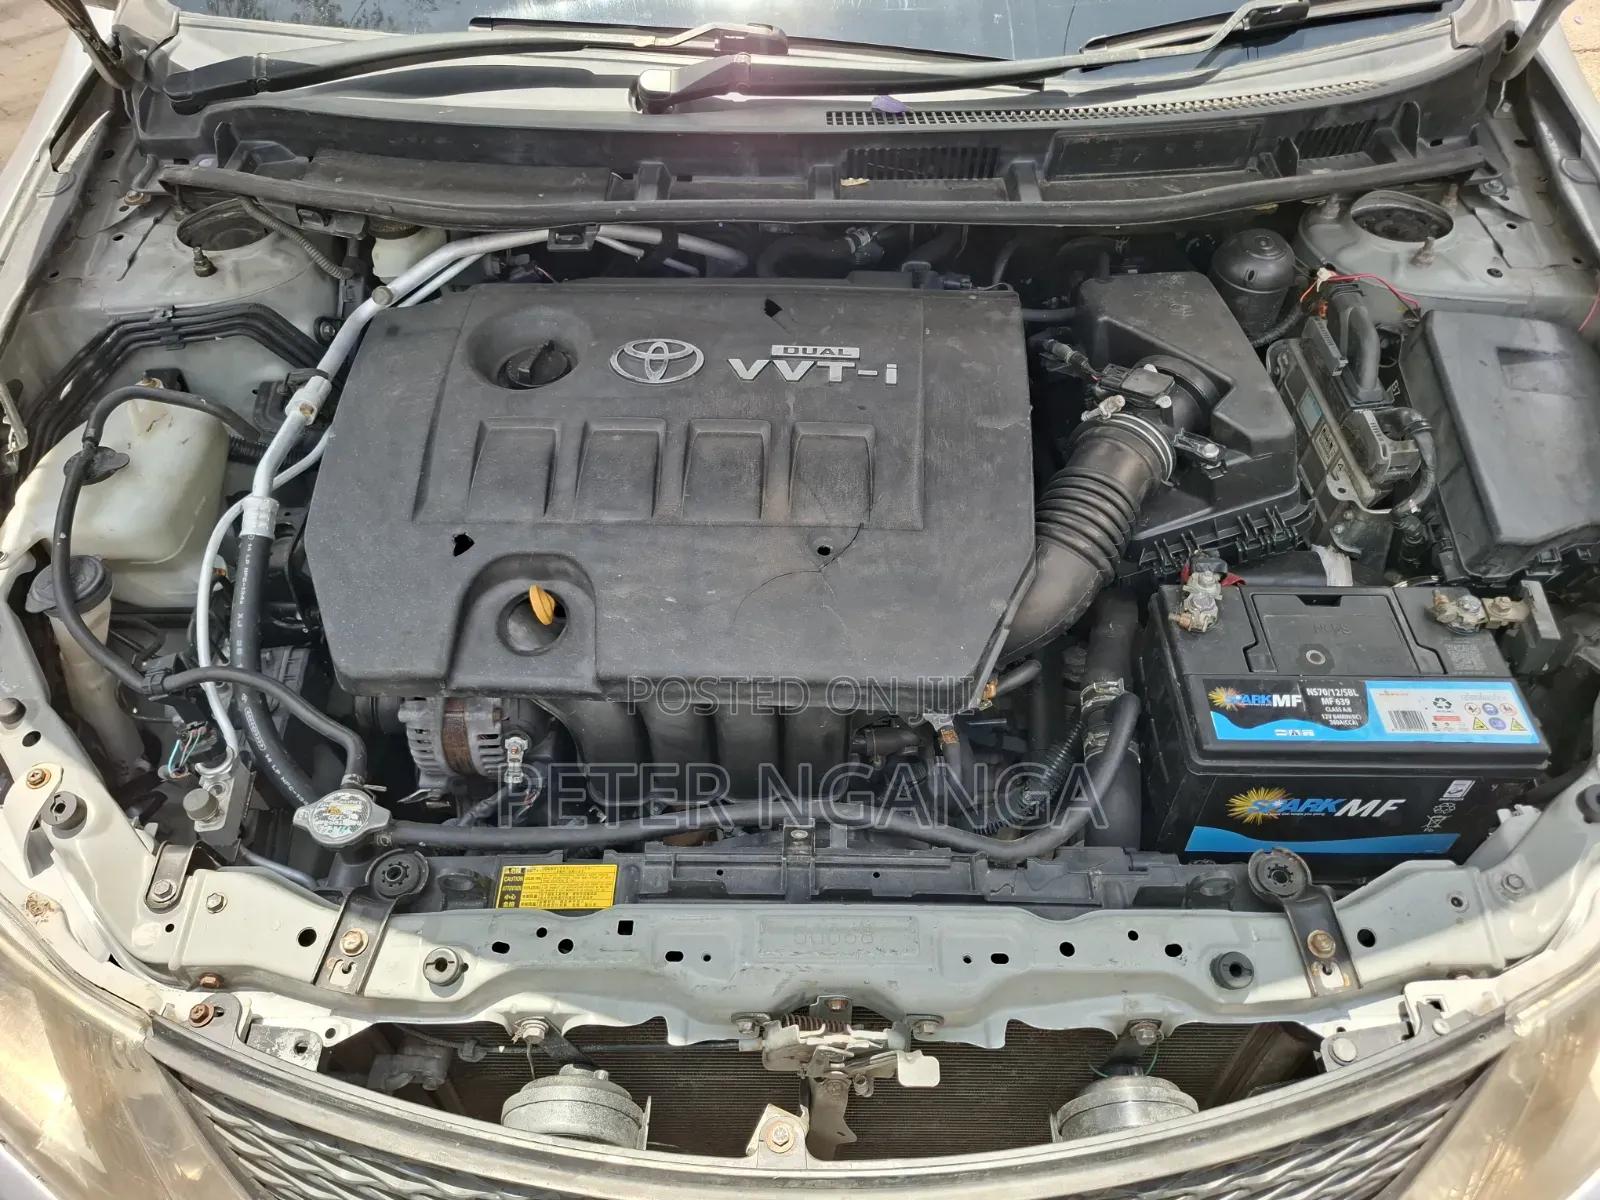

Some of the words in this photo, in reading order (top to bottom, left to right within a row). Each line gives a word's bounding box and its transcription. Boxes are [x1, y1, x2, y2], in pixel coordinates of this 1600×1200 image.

[783, 346, 852, 357] DUAL
[728, 358, 898, 385] VVT-i
[1272, 694, 1303, 708] MF
[1321, 697, 1333, 706] MF
[1335, 697, 1351, 706] 639
[1247, 798, 1347, 813] SPARK
[1334, 798, 1407, 818] MF
